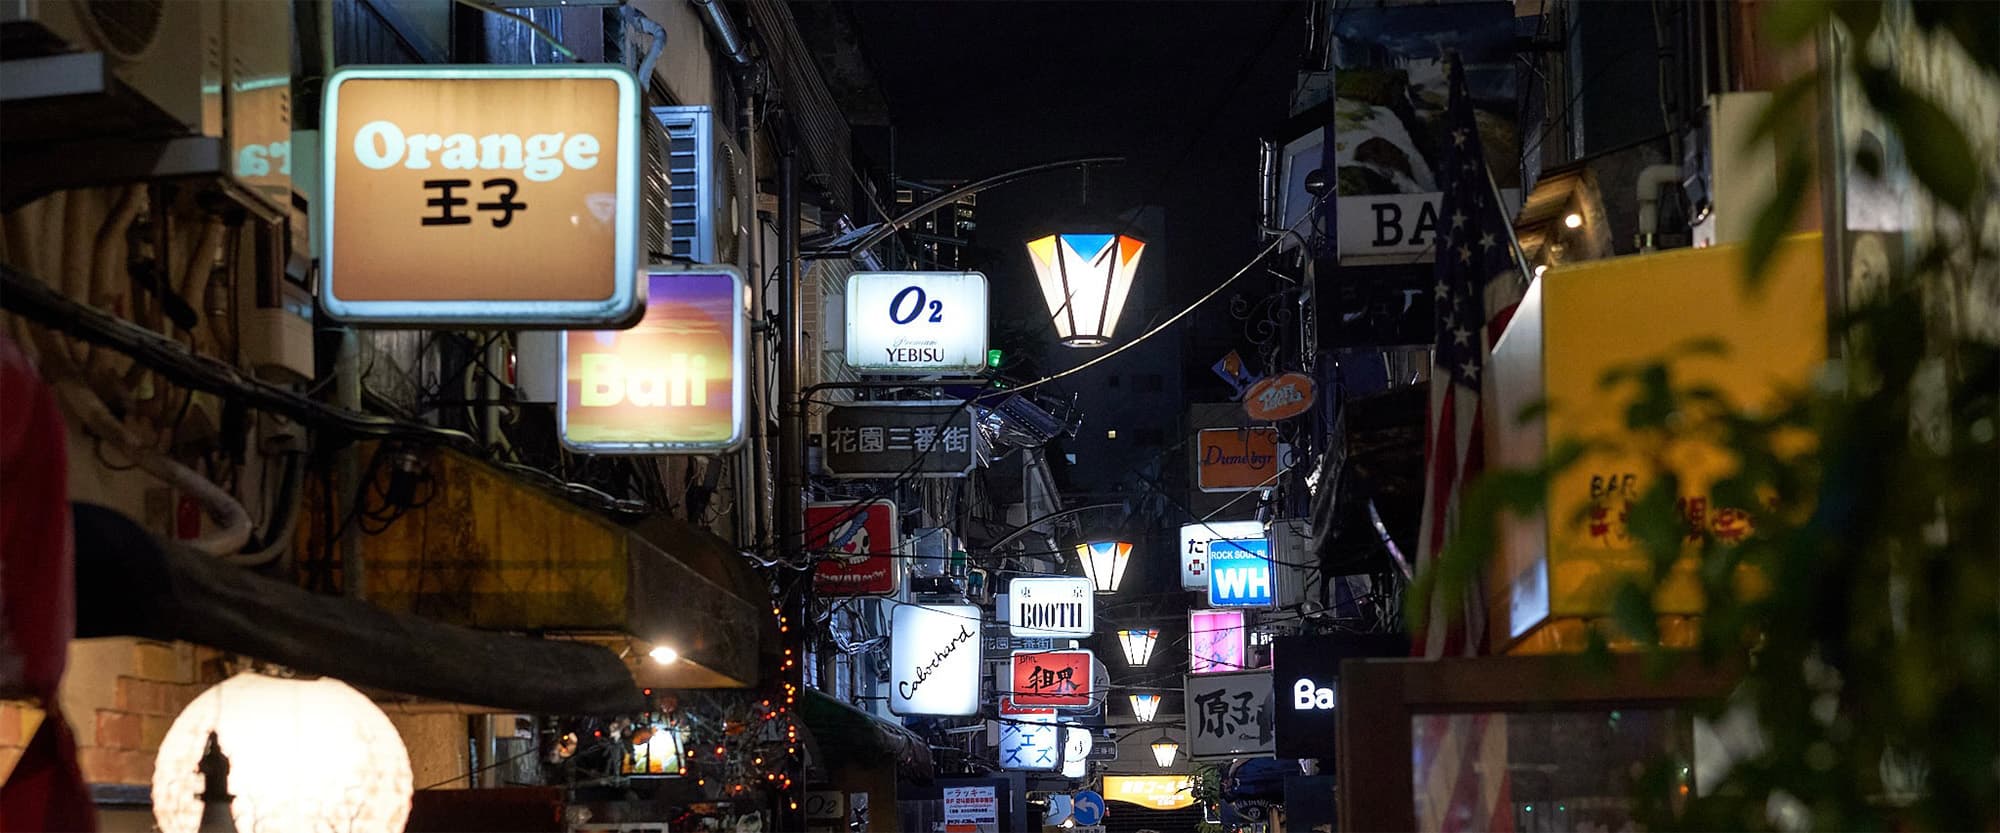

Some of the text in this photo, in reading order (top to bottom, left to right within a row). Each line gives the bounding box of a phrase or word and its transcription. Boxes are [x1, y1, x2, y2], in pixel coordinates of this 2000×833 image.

[353, 120, 600, 181] Orange
[421, 178, 527, 228] 王子
[886, 347, 944, 362] YEBISU
[581, 353, 707, 407] Bali
[830, 425, 969, 454] 花園三番街
[1211, 551, 1234, 560] ROCK
[1020, 602, 1082, 628] BOOTH
